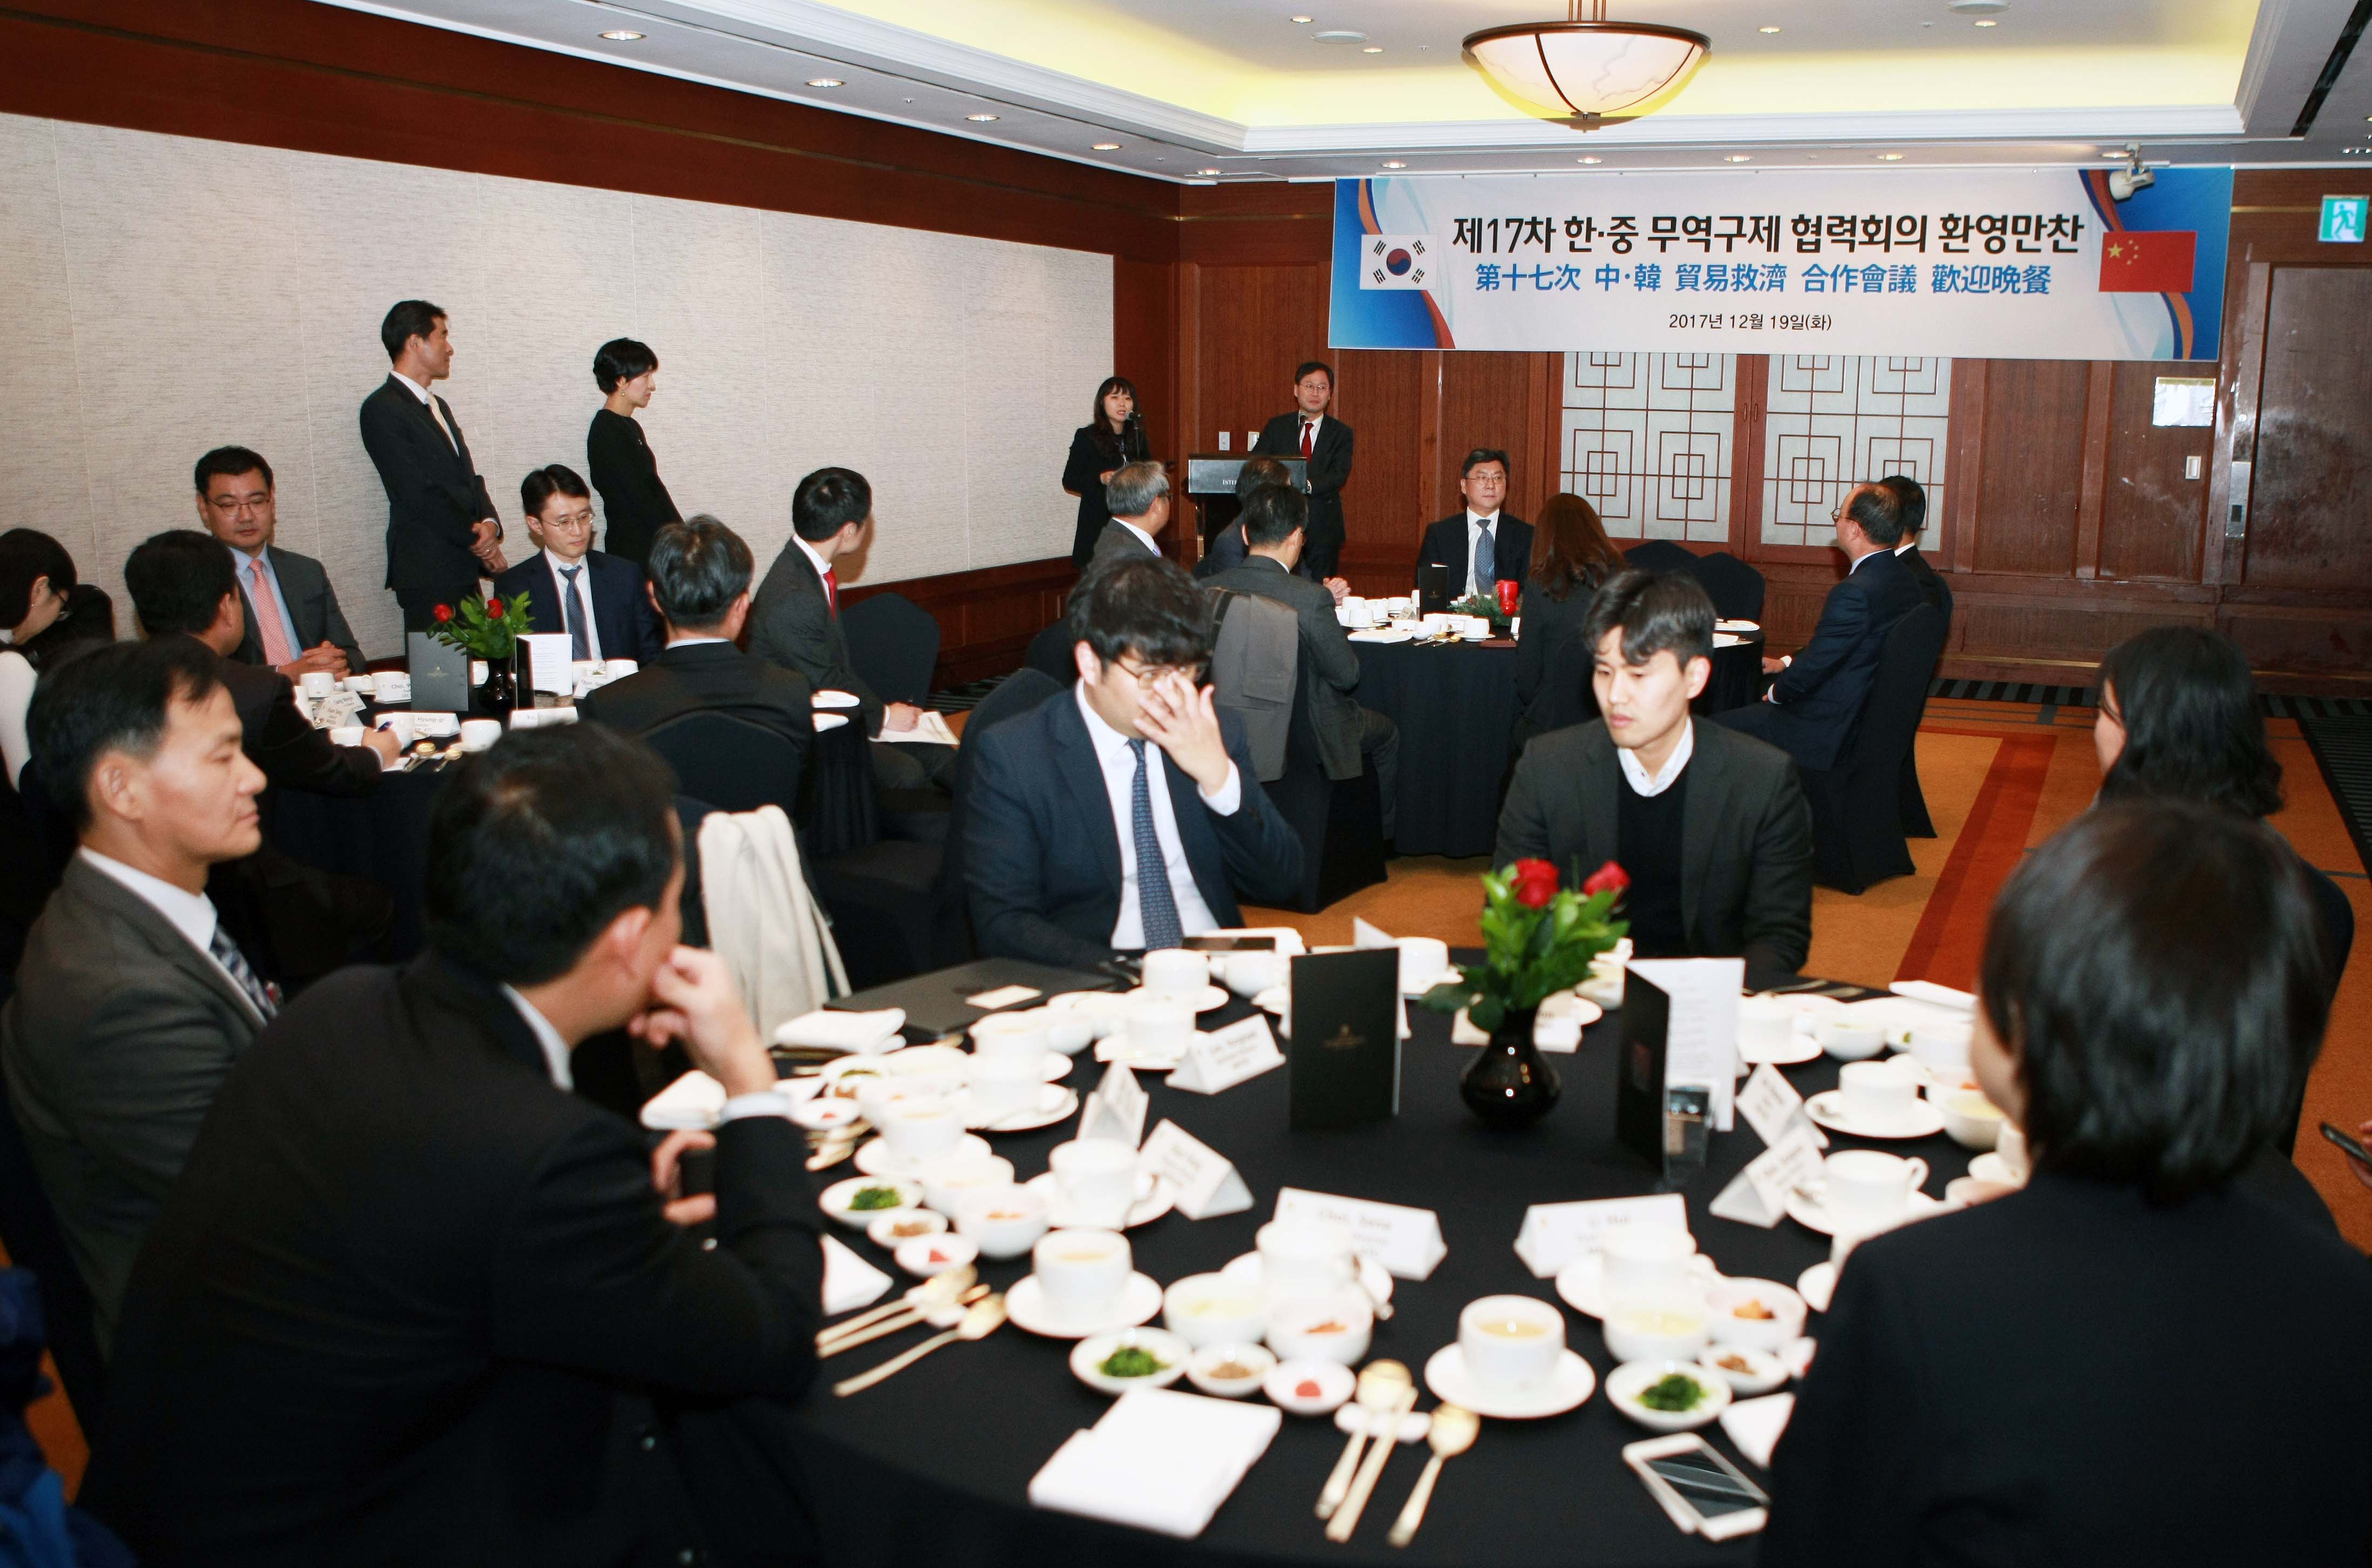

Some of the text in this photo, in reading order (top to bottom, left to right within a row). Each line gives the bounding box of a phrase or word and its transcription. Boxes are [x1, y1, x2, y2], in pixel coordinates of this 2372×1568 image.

[1452, 213, 2085, 255] 제17차 한·중 무역구제 협력회의 환영만찬
[1475, 263, 1582, 292] 第十七次
[1675, 263, 1788, 293] 貿易救濟
[1801, 263, 1917, 294] 合作會議
[1931, 263, 2052, 295] 歡迎晚餐
[1669, 313, 1832, 332] 2017년 12월 19일(화)
